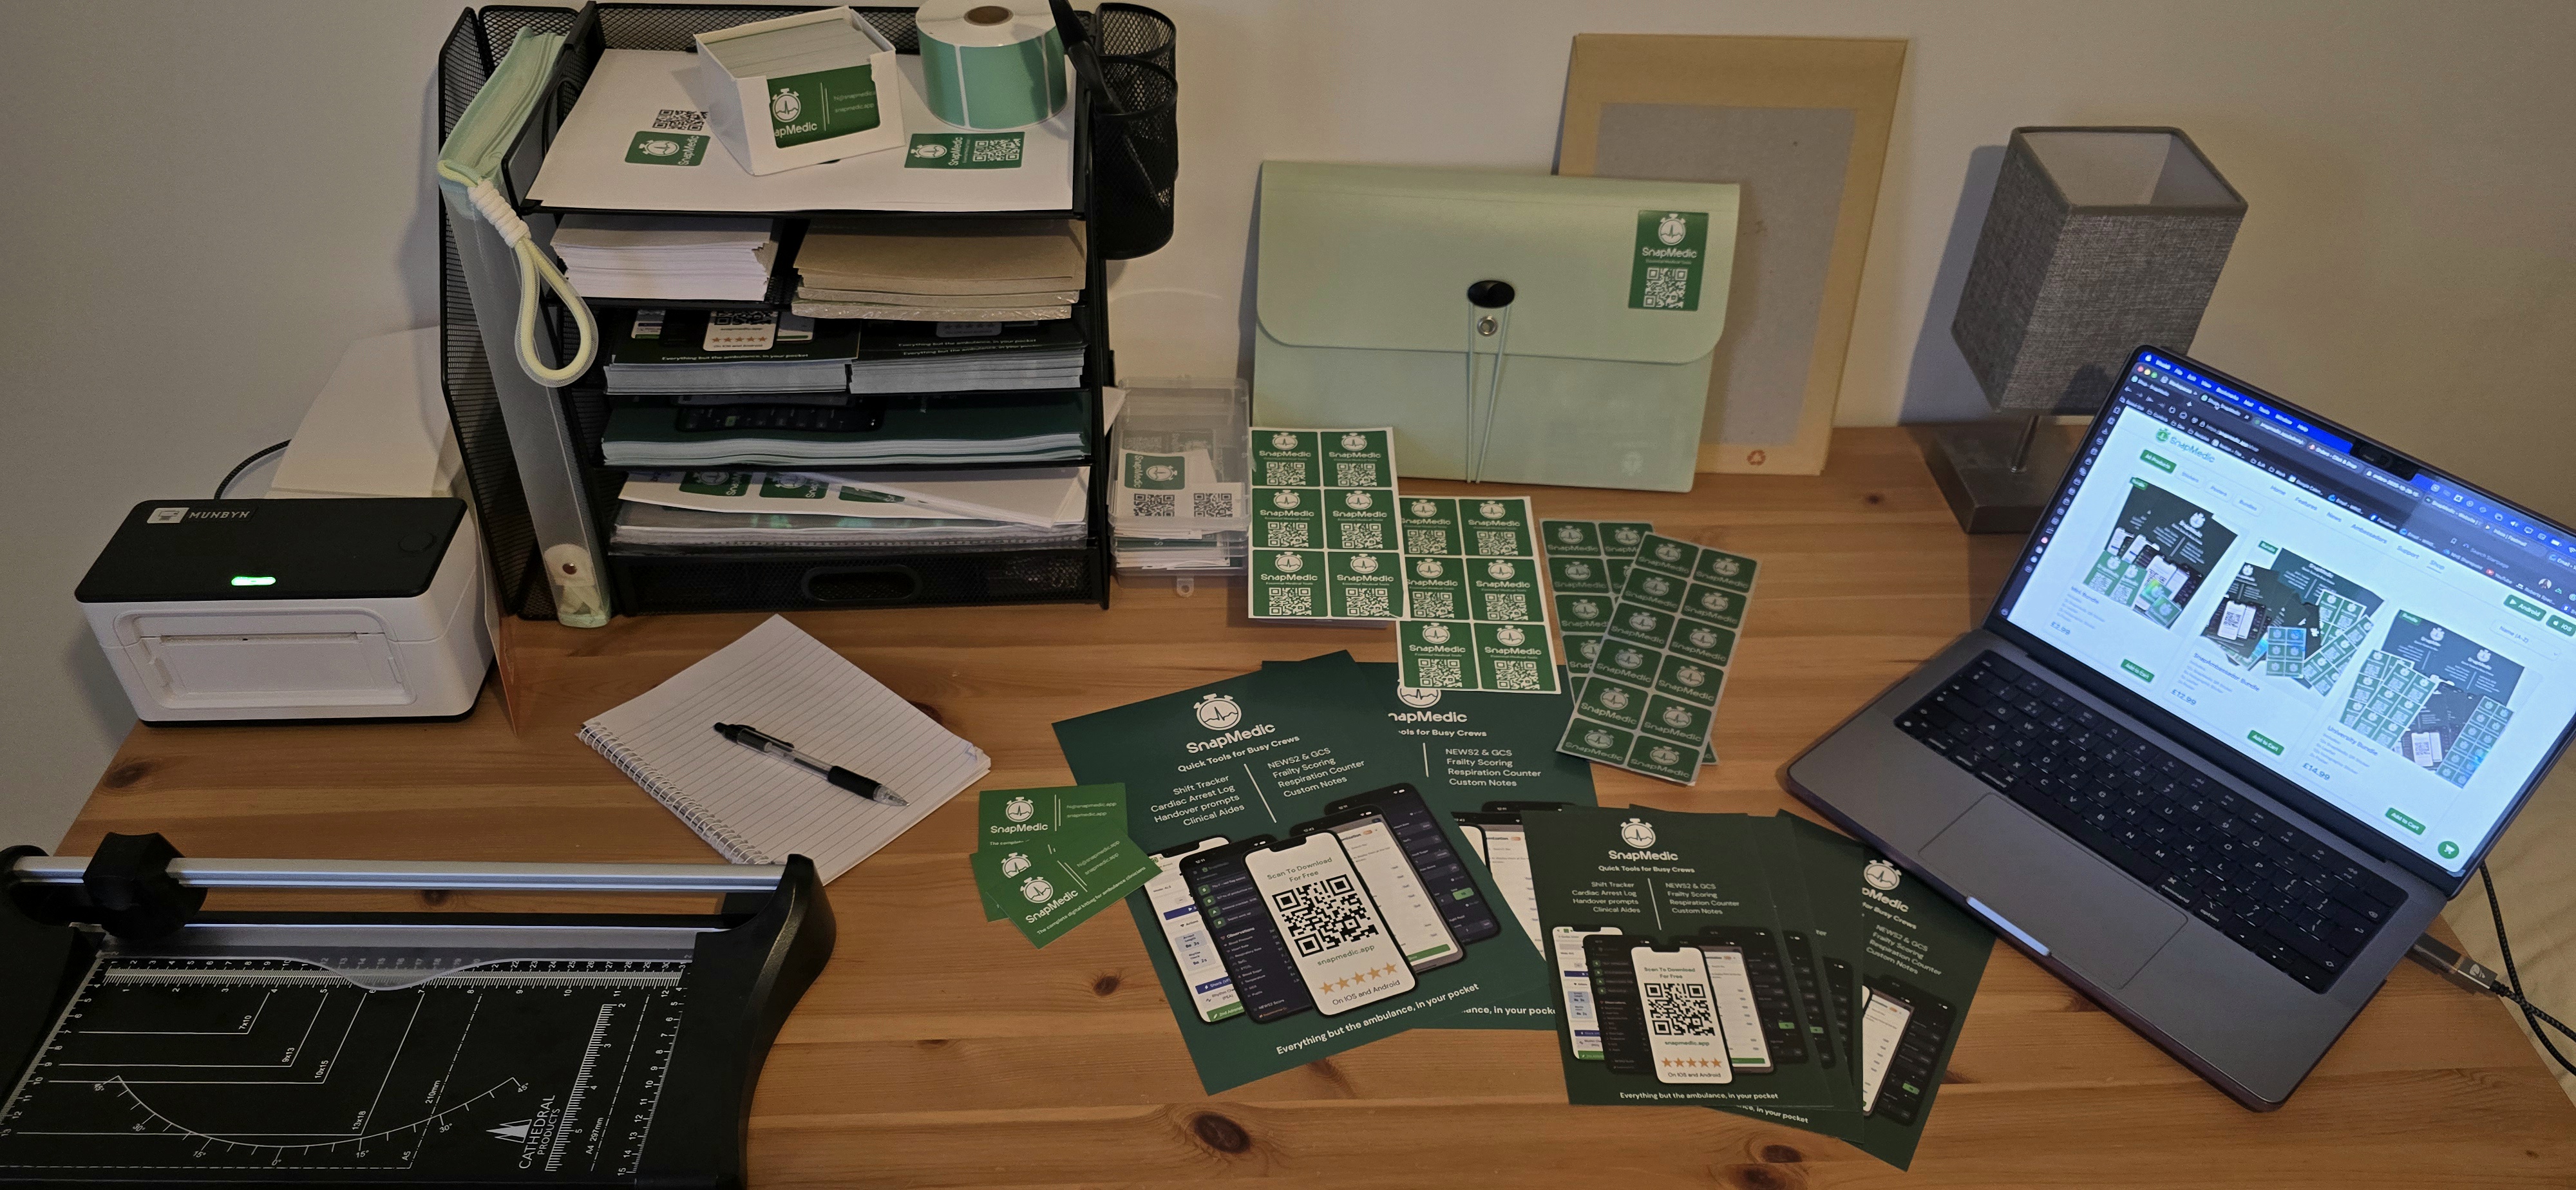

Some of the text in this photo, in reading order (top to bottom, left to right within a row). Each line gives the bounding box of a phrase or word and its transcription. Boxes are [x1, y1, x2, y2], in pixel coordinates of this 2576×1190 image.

[677, 135, 699, 165] SnapMedic
[948, 137, 963, 166] SnapMedic
[1642, 247, 1697, 258] SnapMedic
[2170, 437, 2216, 463] SnapMedic
[1133, 455, 1144, 488] SnapMedic
[2429, 559, 2445, 571] Shop
[2518, 603, 2541, 617] Android
[1409, 645, 1466, 653] SnapMedic
[1484, 647, 1542, 655] SnapMedic
[1596, 663, 1652, 683] SnapMedic
[1658, 680, 1714, 701] SnapMedic
[1581, 703, 1637, 724] SnapMedic
[1186, 722, 1276, 754] SnapMedic
[1432, 729, 1455, 737] Busy
[1643, 722, 1701, 742] SnapMedic
[1177, 735, 1300, 773] Quick Tools for Busy Crews
[1267, 755, 1300, 770] NEWS2
[1311, 747, 1331, 759] GCS
[1565, 742, 1624, 761] SnapMedic
[1273, 757, 1336, 779] Frailty Scoring
[1278, 760, 1365, 788] Respiration Counter
[1448, 768, 1501, 777] Respiration
[1477, 759, 1513, 768] Scoring
[1631, 759, 1690, 778] SnapMedic
[2302, 762, 2331, 780] £14.99
[1173, 775, 1229, 796] Shift Tracker
[1283, 775, 1347, 798] Custom Notes
[1150, 784, 1235, 813] Cardiac Arrest Log
[1154, 795, 1240, 823] Handover prompts
[1183, 805, 1245, 827] Clinical Aides
[990, 823, 1048, 834] SnapMedic
[1608, 850, 1678, 862] SnapMedic
[1267, 871, 1286, 880] Scan
[1296, 857, 1332, 871] Download
[1302, 871, 1319, 879] Free
[1025, 890, 1078, 923] SnapMedic
[1046, 915, 1068, 930] complete
[1068, 905, 1082, 917] digital
[1103, 879, 1126, 896] ambulance
[1318, 945, 1375, 966] snapmedic.app
[1358, 989, 1372, 997] and
[1373, 979, 1401, 994] Android
[238, 1015, 252, 1030] 7x10
[1276, 983, 1479, 1055] Everything but the ambulance, in your pocket
[281, 1046, 295, 1064] 9x13
[314, 1060, 328, 1079] 10x15
[424, 1079, 441, 1105] 210mm
[352, 1110, 366, 1131] 13x18
[634, 1114, 643, 1123] 12
[519, 1095, 556, 1169] CATHEDRAL
[537, 1108, 560, 1155] PRODUCTS
[585, 1117, 604, 1155] A4 297mm
[629, 1132, 638, 1140] 13
[623, 1149, 632, 1158] 14
[618, 1167, 627, 1176] 15
